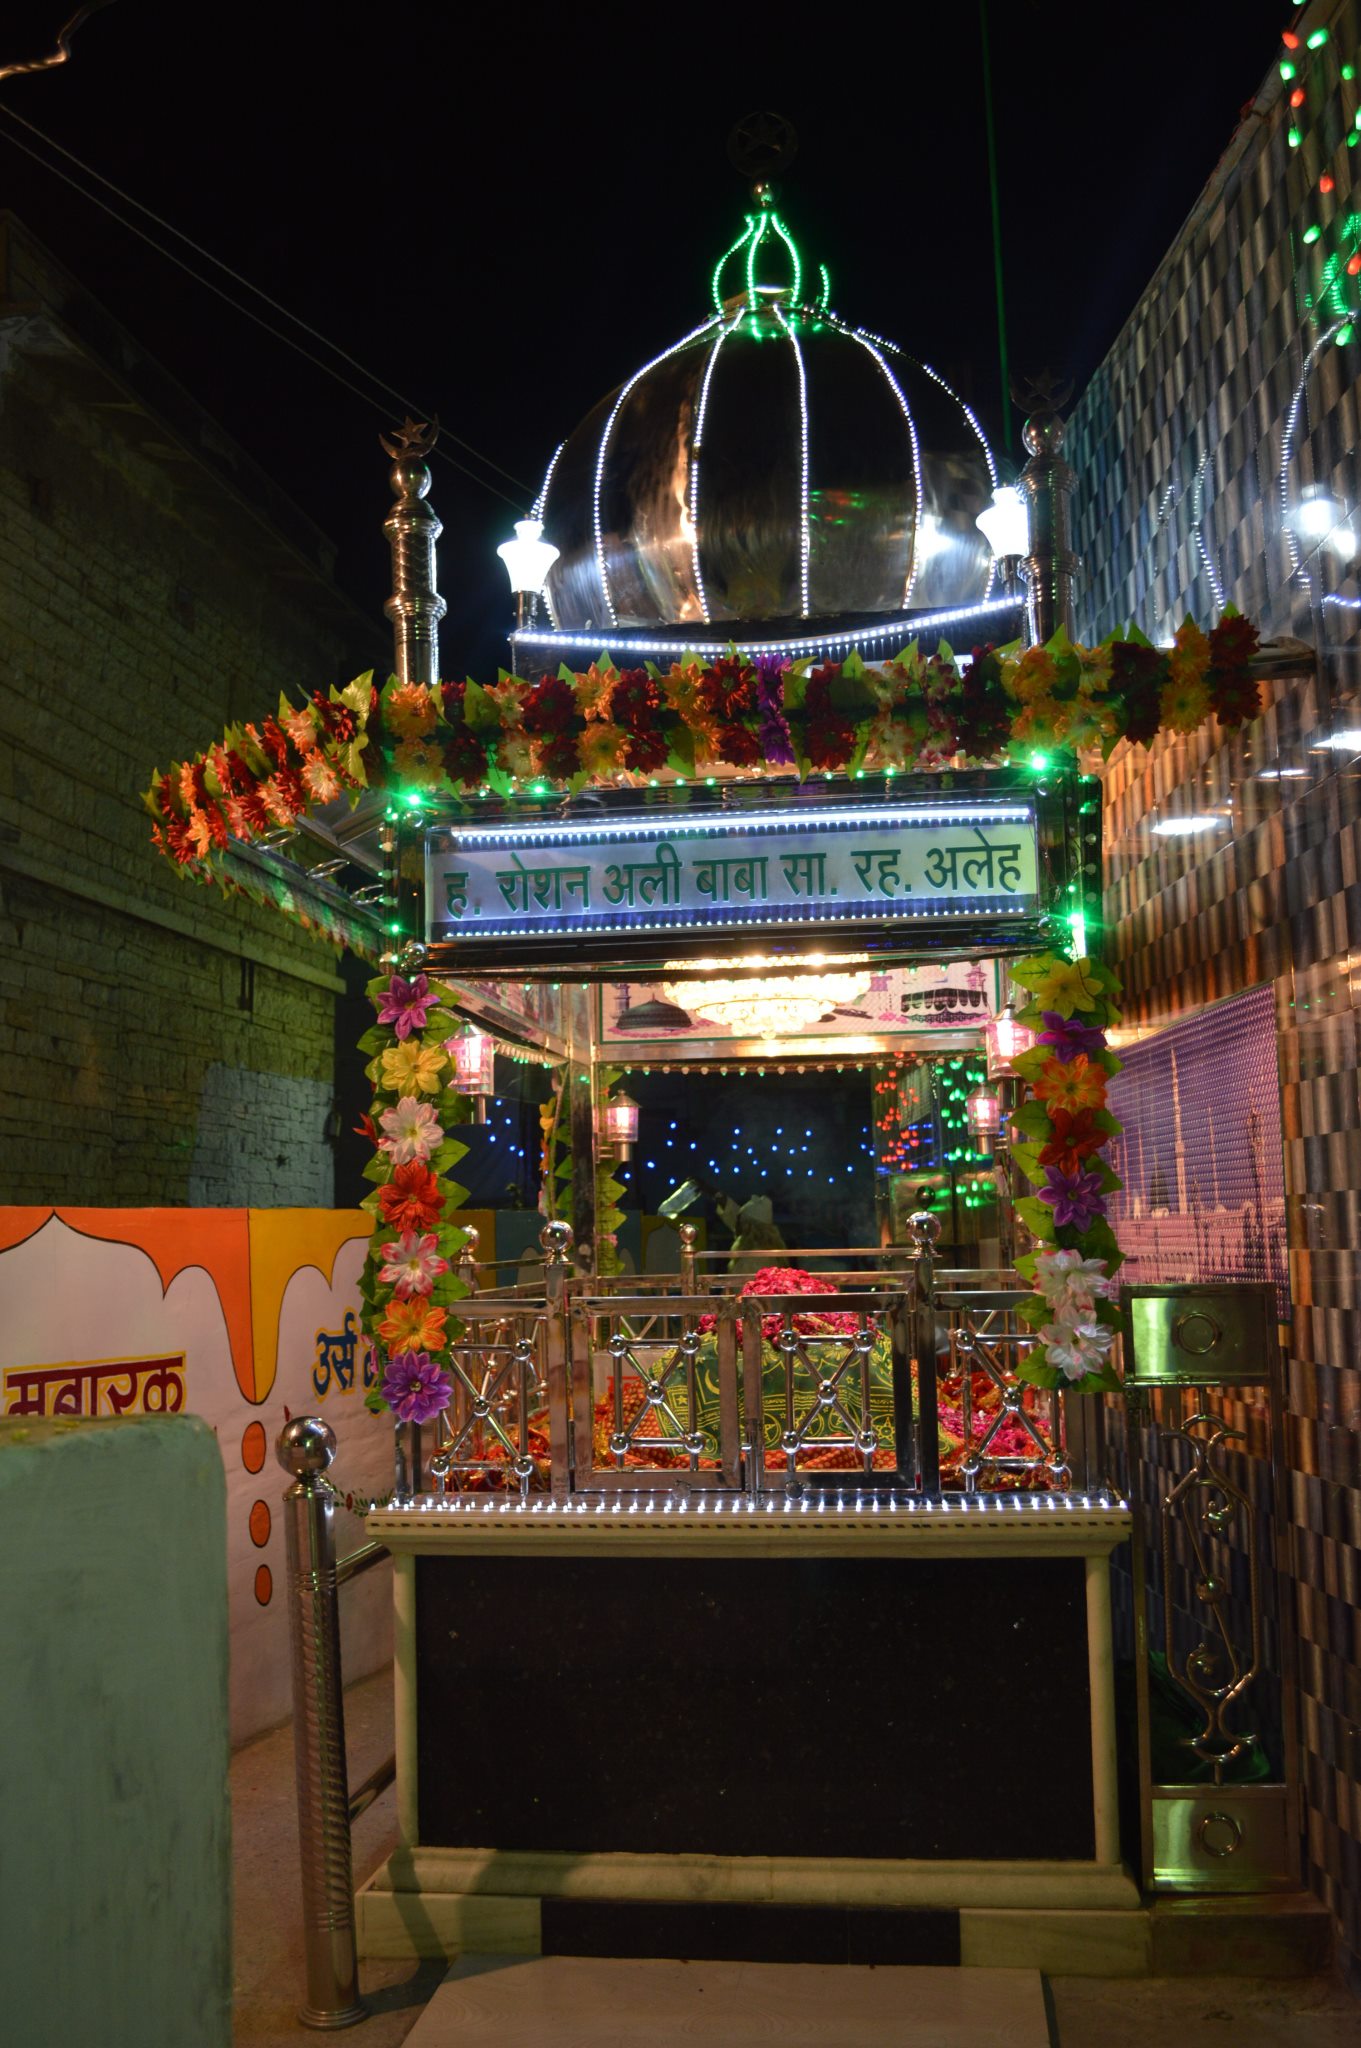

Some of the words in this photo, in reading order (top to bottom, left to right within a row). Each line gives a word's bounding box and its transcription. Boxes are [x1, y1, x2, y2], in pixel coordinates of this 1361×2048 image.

[443, 872, 481, 919] ह.
[495, 852, 591, 912] रोशन
[602, 843, 683, 907] अली
[692, 856, 768, 902] बाबा
[779, 852, 838, 897] सा.
[850, 849, 912, 898] रह.
[923, 827, 1022, 894] अलेह
[312, 1309, 358, 1398] उर्स
